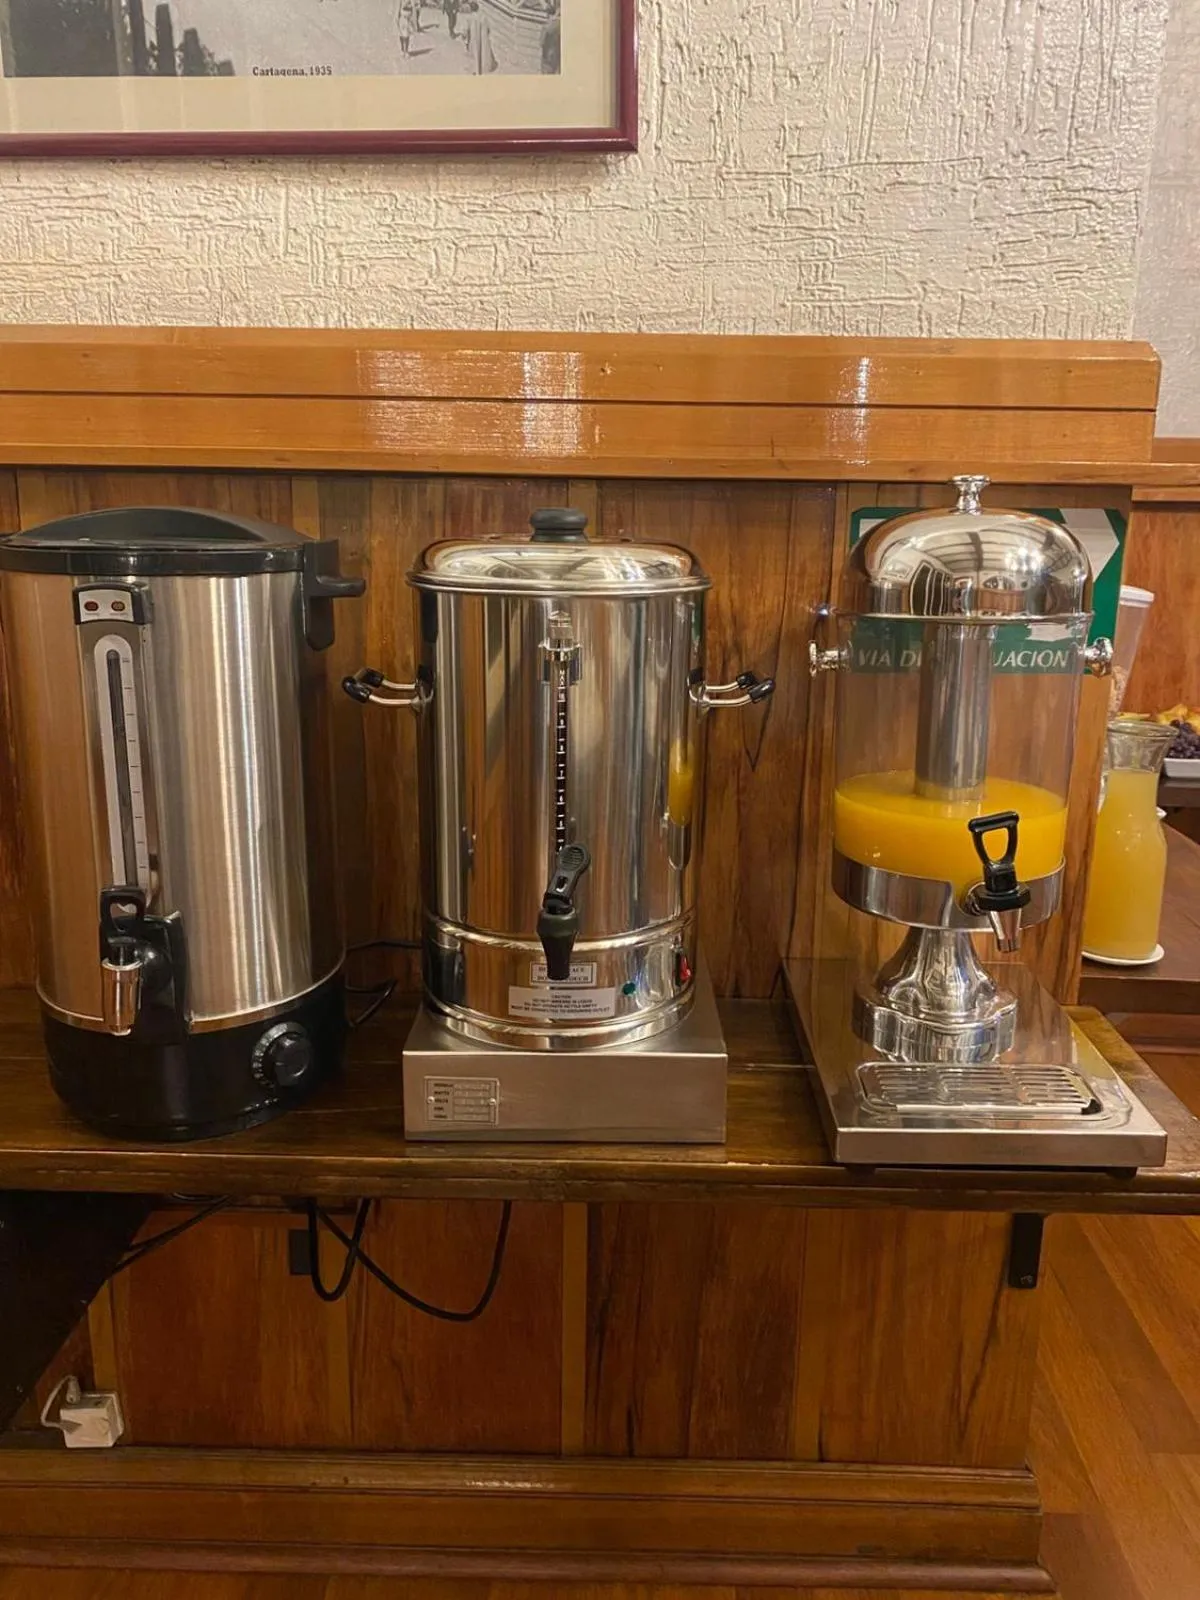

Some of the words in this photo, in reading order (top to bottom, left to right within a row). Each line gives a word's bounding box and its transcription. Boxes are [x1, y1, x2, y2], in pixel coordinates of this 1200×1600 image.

[252, 66, 308, 77] Cartagena,
[310, 65, 332, 76] 1935
[858, 649, 891, 667] VIA
[900, 649, 922, 667] D
